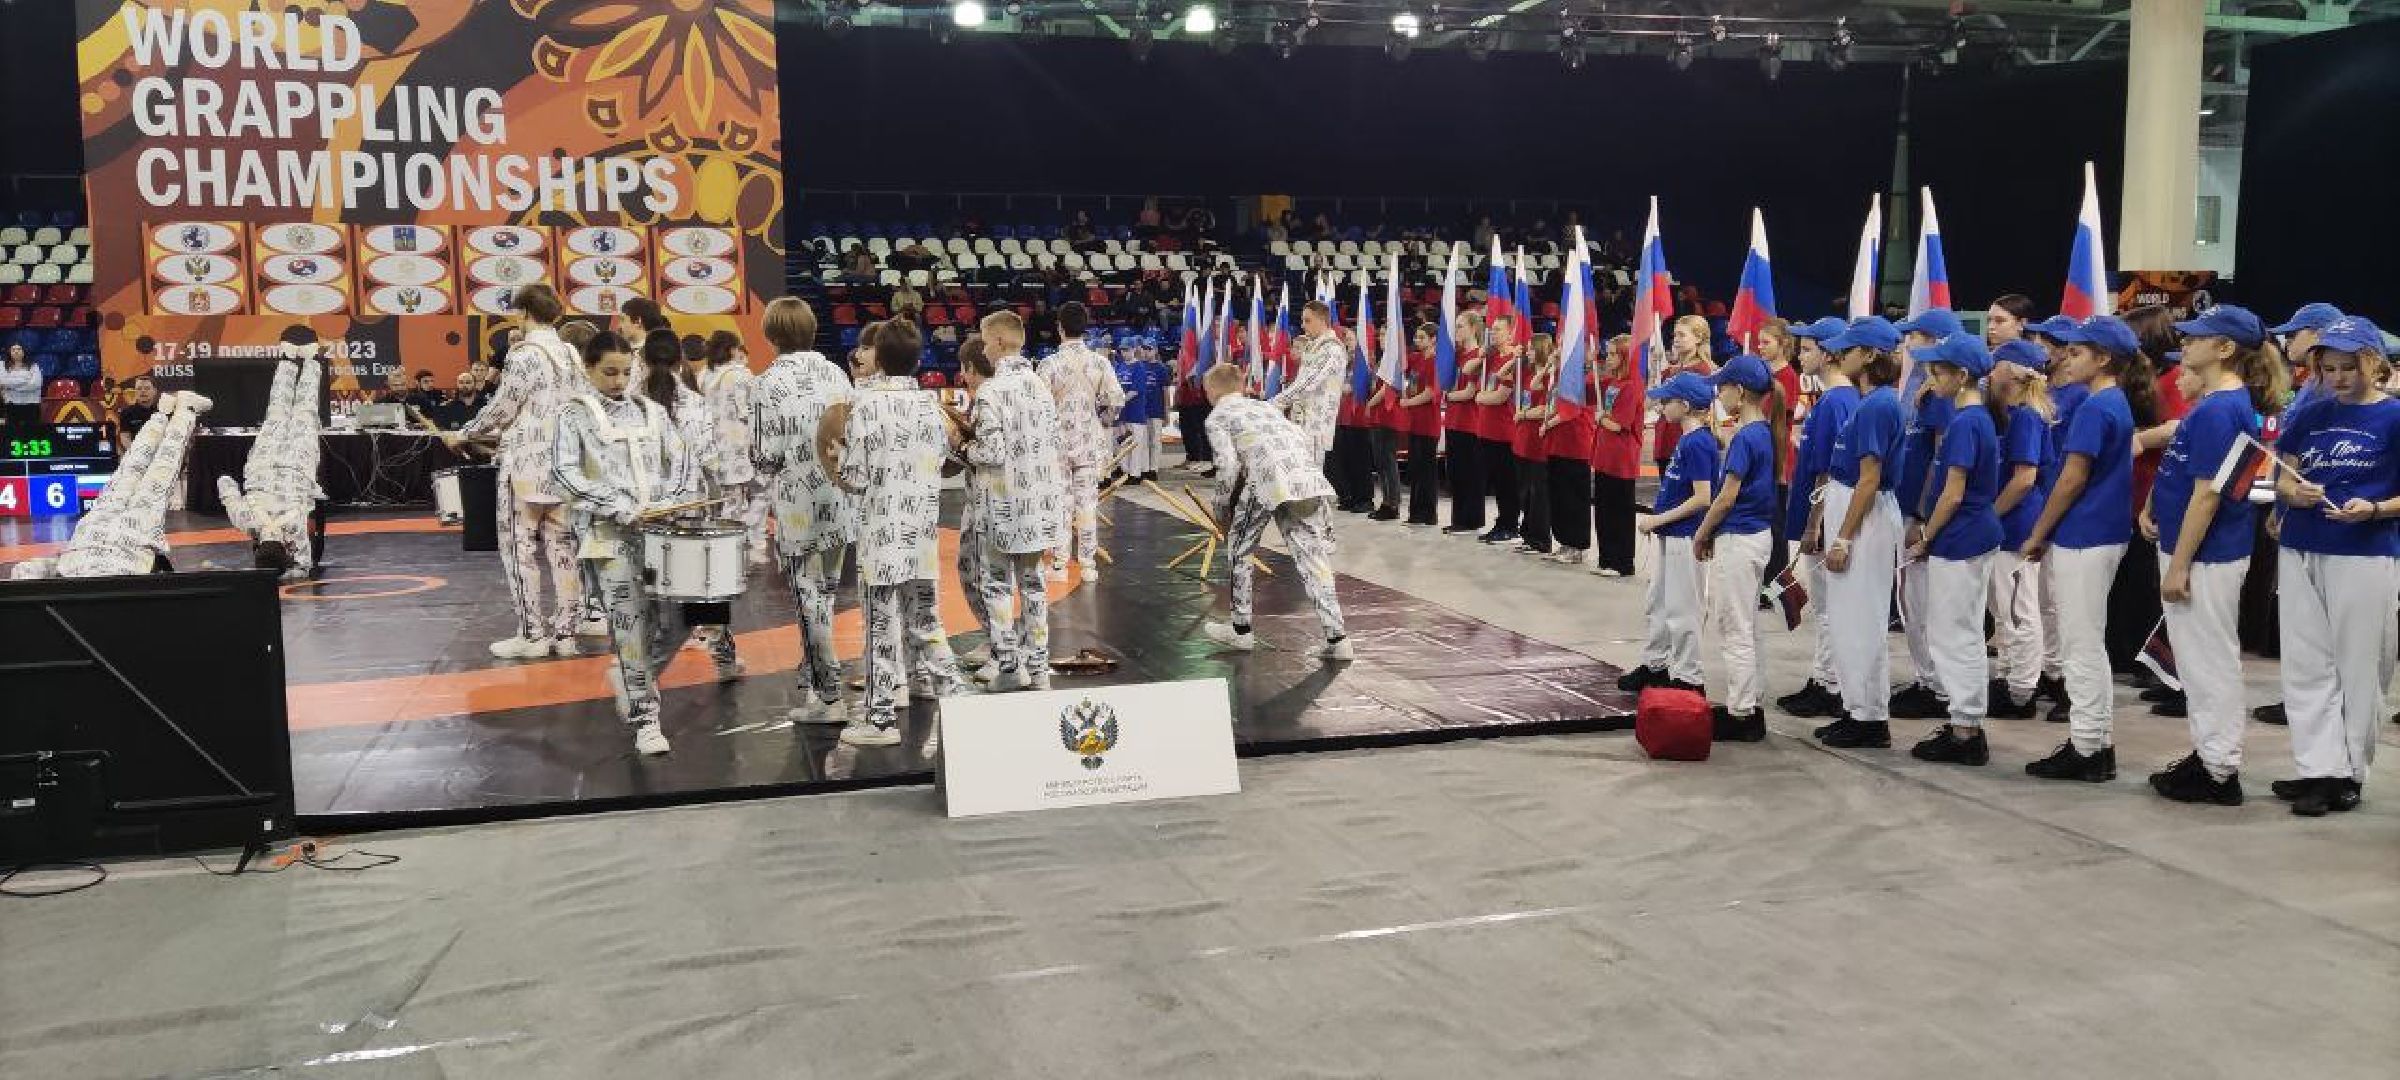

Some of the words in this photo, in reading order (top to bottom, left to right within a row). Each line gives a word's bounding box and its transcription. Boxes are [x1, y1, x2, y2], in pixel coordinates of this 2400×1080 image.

[122, 8, 361, 71] WORLD
[132, 77, 506, 145] GRAPPLING
[136, 148, 679, 213] CHAMPIONSHIPS
[2136, 293, 2170, 304] WORLD
[153, 341, 212, 360] 17-19
[219, 345, 280, 359] novem
[323, 340, 376, 359] 2023
[153, 364, 195, 377] RUSS
[329, 365, 367, 376] rocus
[10, 440, 52, 456] 3:33
[0, 484, 17, 509] 4
[47, 482, 65, 508] 6
